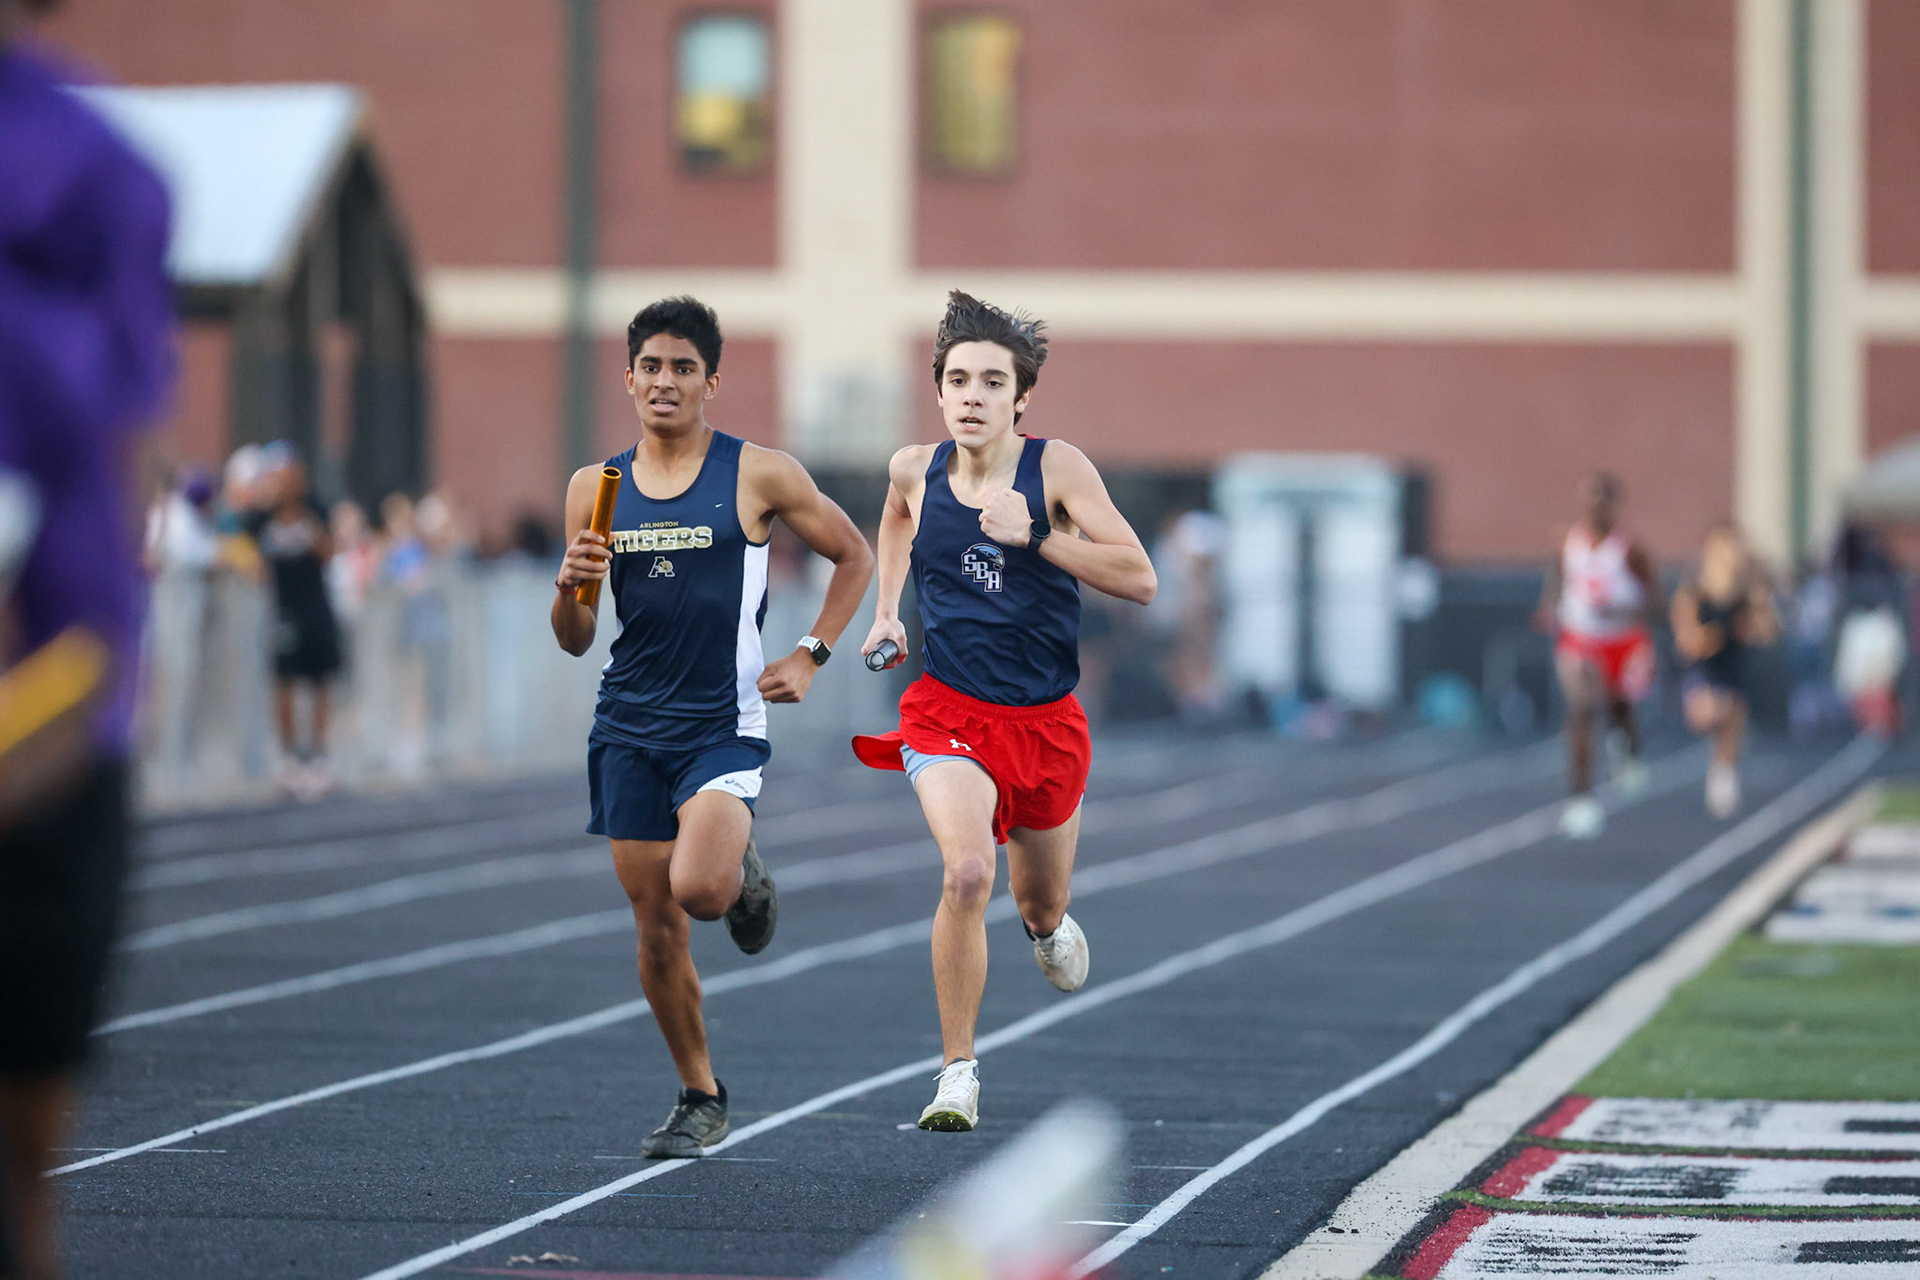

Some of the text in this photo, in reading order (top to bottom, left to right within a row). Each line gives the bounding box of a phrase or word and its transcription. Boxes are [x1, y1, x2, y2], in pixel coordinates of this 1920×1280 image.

[639, 521, 679, 529] ARLINGTON
[611, 526, 713, 553] TIGERS
[963, 554, 1000, 590] SBA
